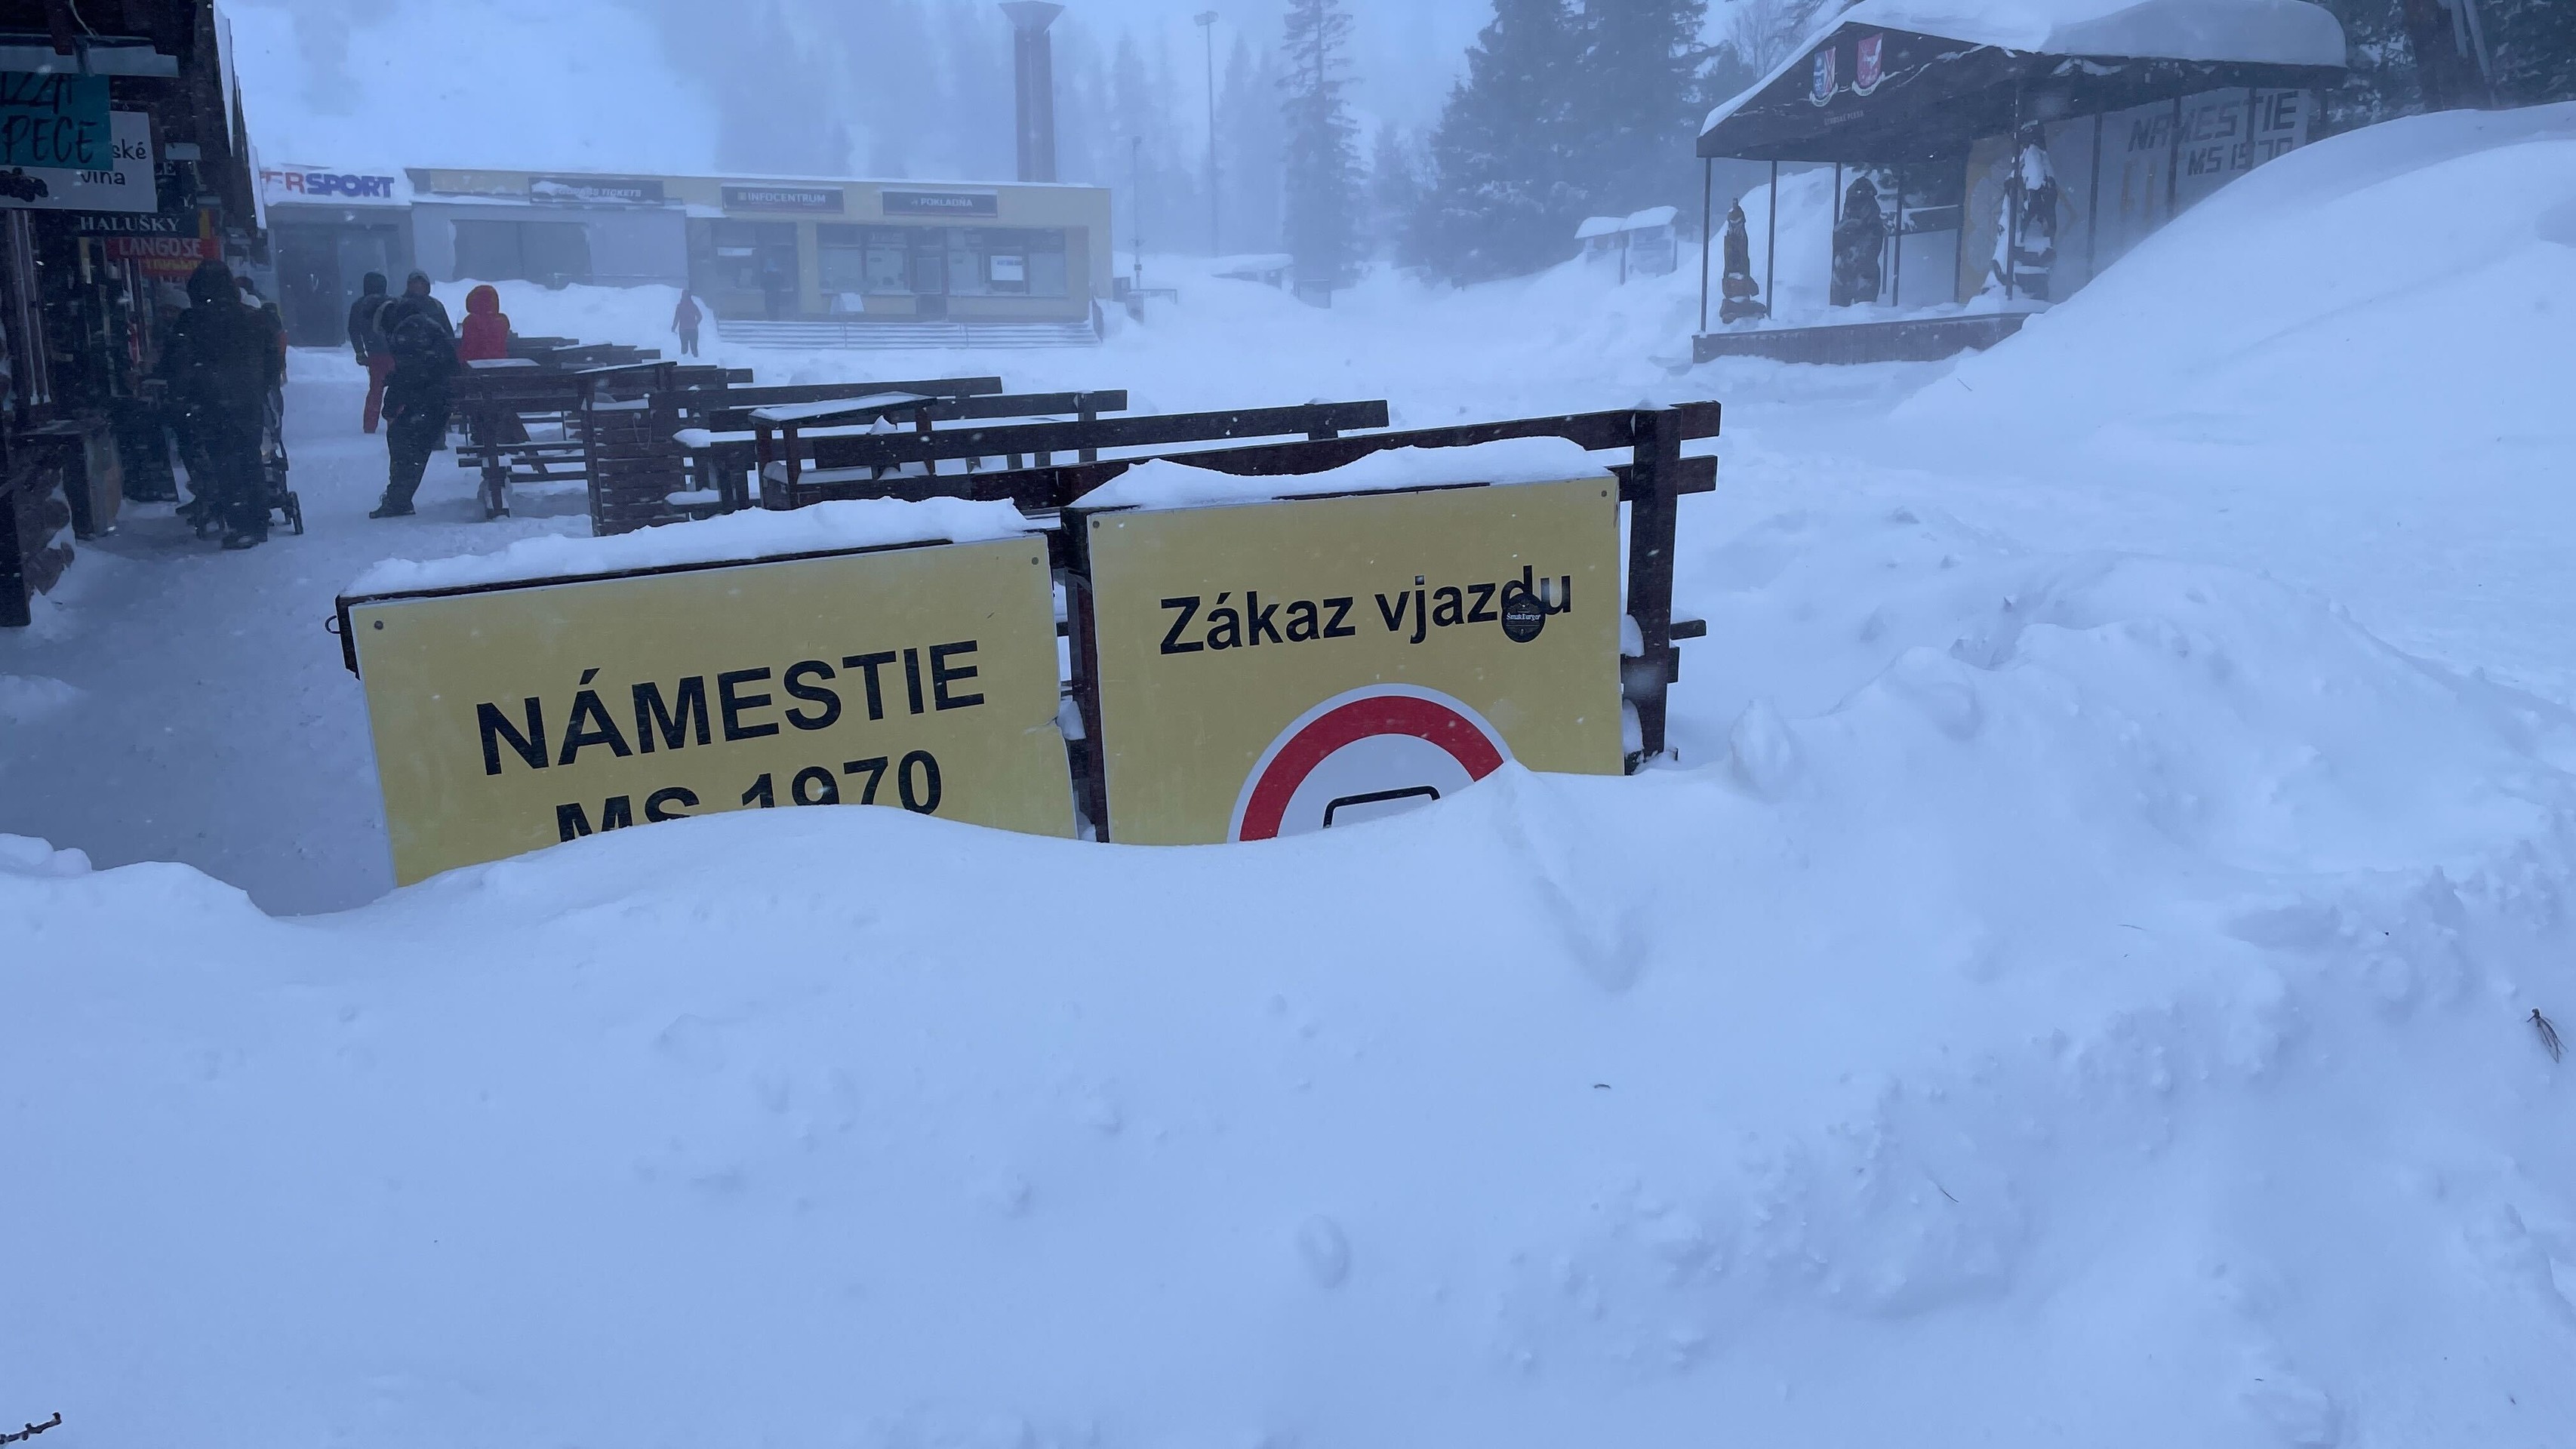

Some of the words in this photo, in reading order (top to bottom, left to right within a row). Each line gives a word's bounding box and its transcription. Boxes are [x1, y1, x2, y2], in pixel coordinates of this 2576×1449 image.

[2187, 145, 2224, 177] MS
[602, 189, 642, 198] TICKETS
[747, 192, 826, 204] INFOCENTRUM
[920, 196, 973, 208] POKLADŇA
[80, 214, 180, 232] HALUŠKY
[1159, 589, 1356, 655] Zákaz
[1374, 565, 1571, 645] vjazdu
[475, 640, 985, 776] NÁMESTIE
[556, 786, 701, 842] MS
[740, 750, 943, 816] 1970
